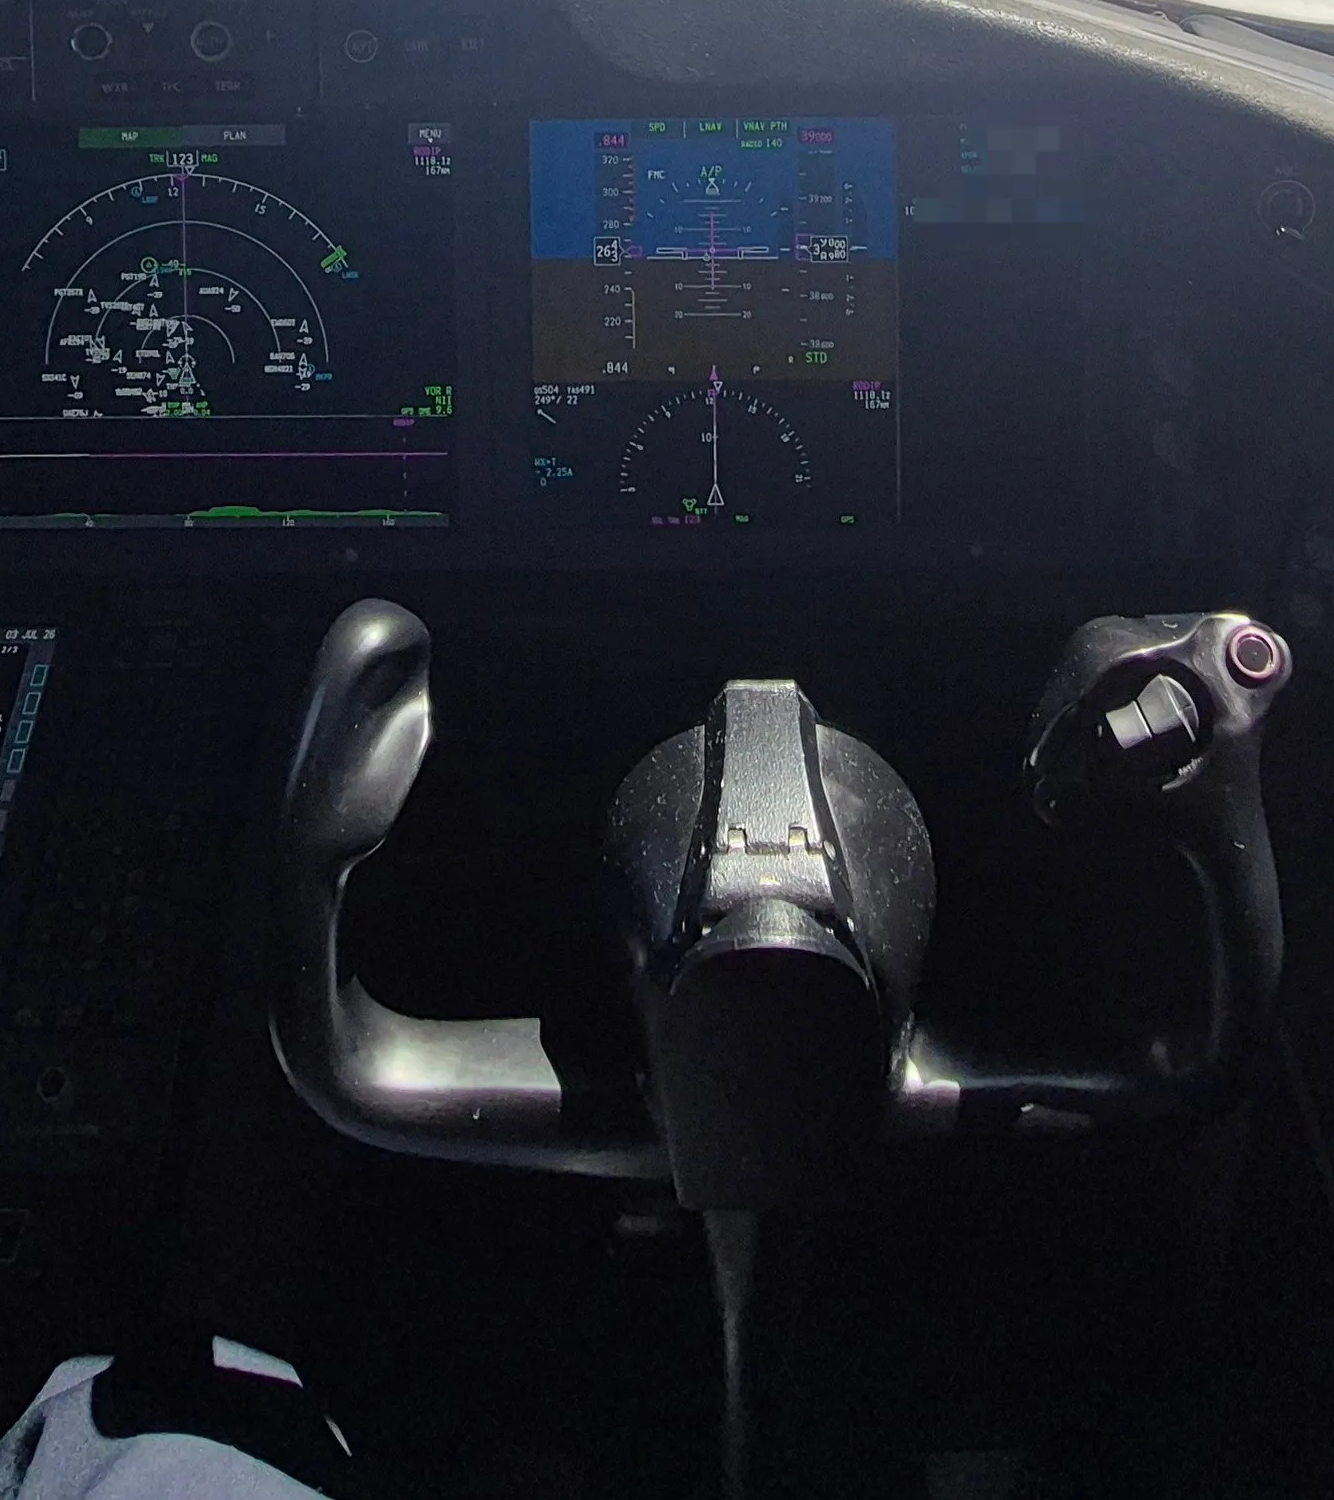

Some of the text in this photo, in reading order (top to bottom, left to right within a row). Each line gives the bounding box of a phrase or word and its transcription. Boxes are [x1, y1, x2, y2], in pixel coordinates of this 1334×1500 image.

[648, 122, 666, 132] SPD
[699, 121, 723, 132] LNAV
[743, 120, 787, 132] VNAV PTH
[121, 130, 247, 142] MAP PLAN
[419, 128, 442, 139] MENU
[801, 130, 833, 142] 39000
[599, 134, 625, 147] .844
[766, 138, 783, 148] 140
[148, 152, 218, 165] TRK 123 MAG
[602, 154, 619, 165] 320
[647, 169, 666, 180] FMC
[700, 165, 723, 178] A/P
[168, 187, 179, 198] 12
[602, 186, 620, 197] 300
[602, 219, 620, 230] 280
[603, 284, 621, 294] 240
[603, 316, 621, 326] 220
[805, 352, 828, 364] STD
[602, 361, 628, 374] .844
[567, 395, 578, 405] 22
[700, 432, 713, 443] 10
[5, 629, 19, 640] 03
[21, 629, 38, 640] JUL
